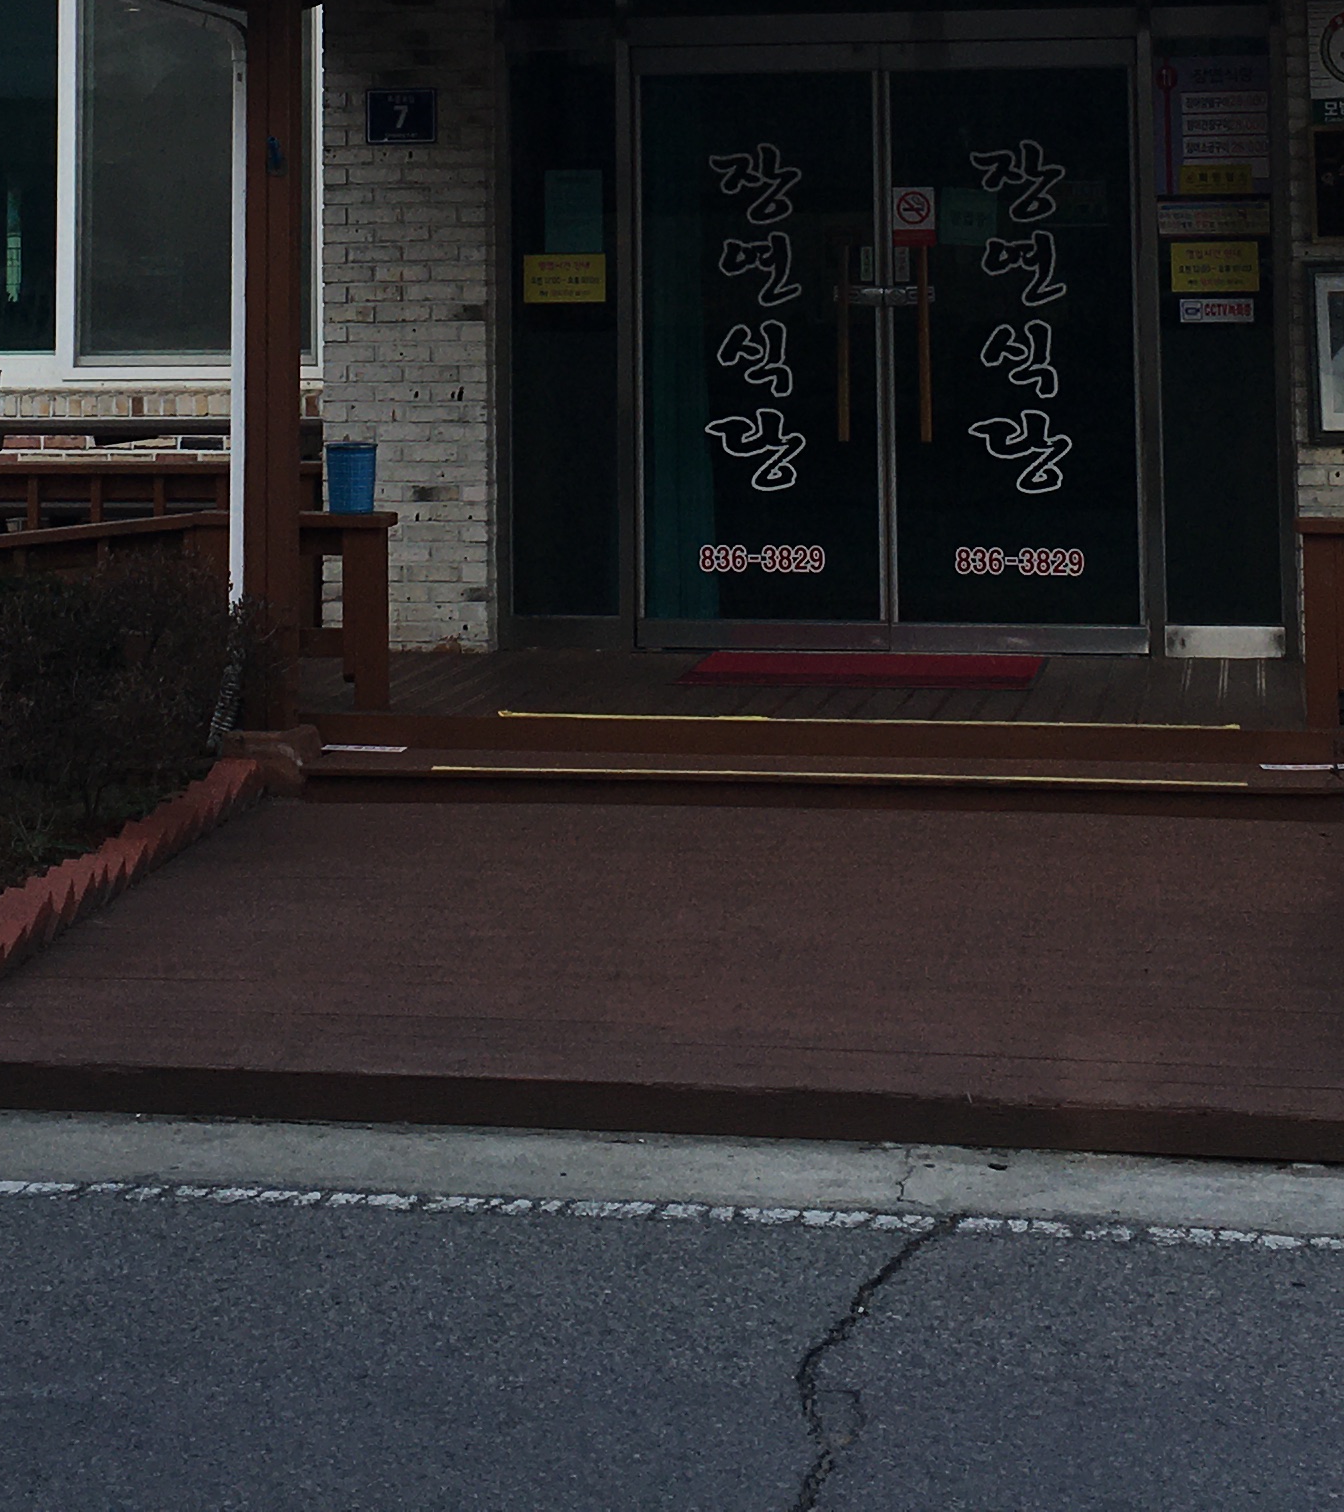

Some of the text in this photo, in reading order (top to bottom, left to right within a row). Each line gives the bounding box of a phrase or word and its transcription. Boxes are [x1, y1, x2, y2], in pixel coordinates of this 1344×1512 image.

[393, 105, 408, 128] 7
[698, 544, 826, 574] 836-3829
[955, 546, 1085, 577] 836-3829
